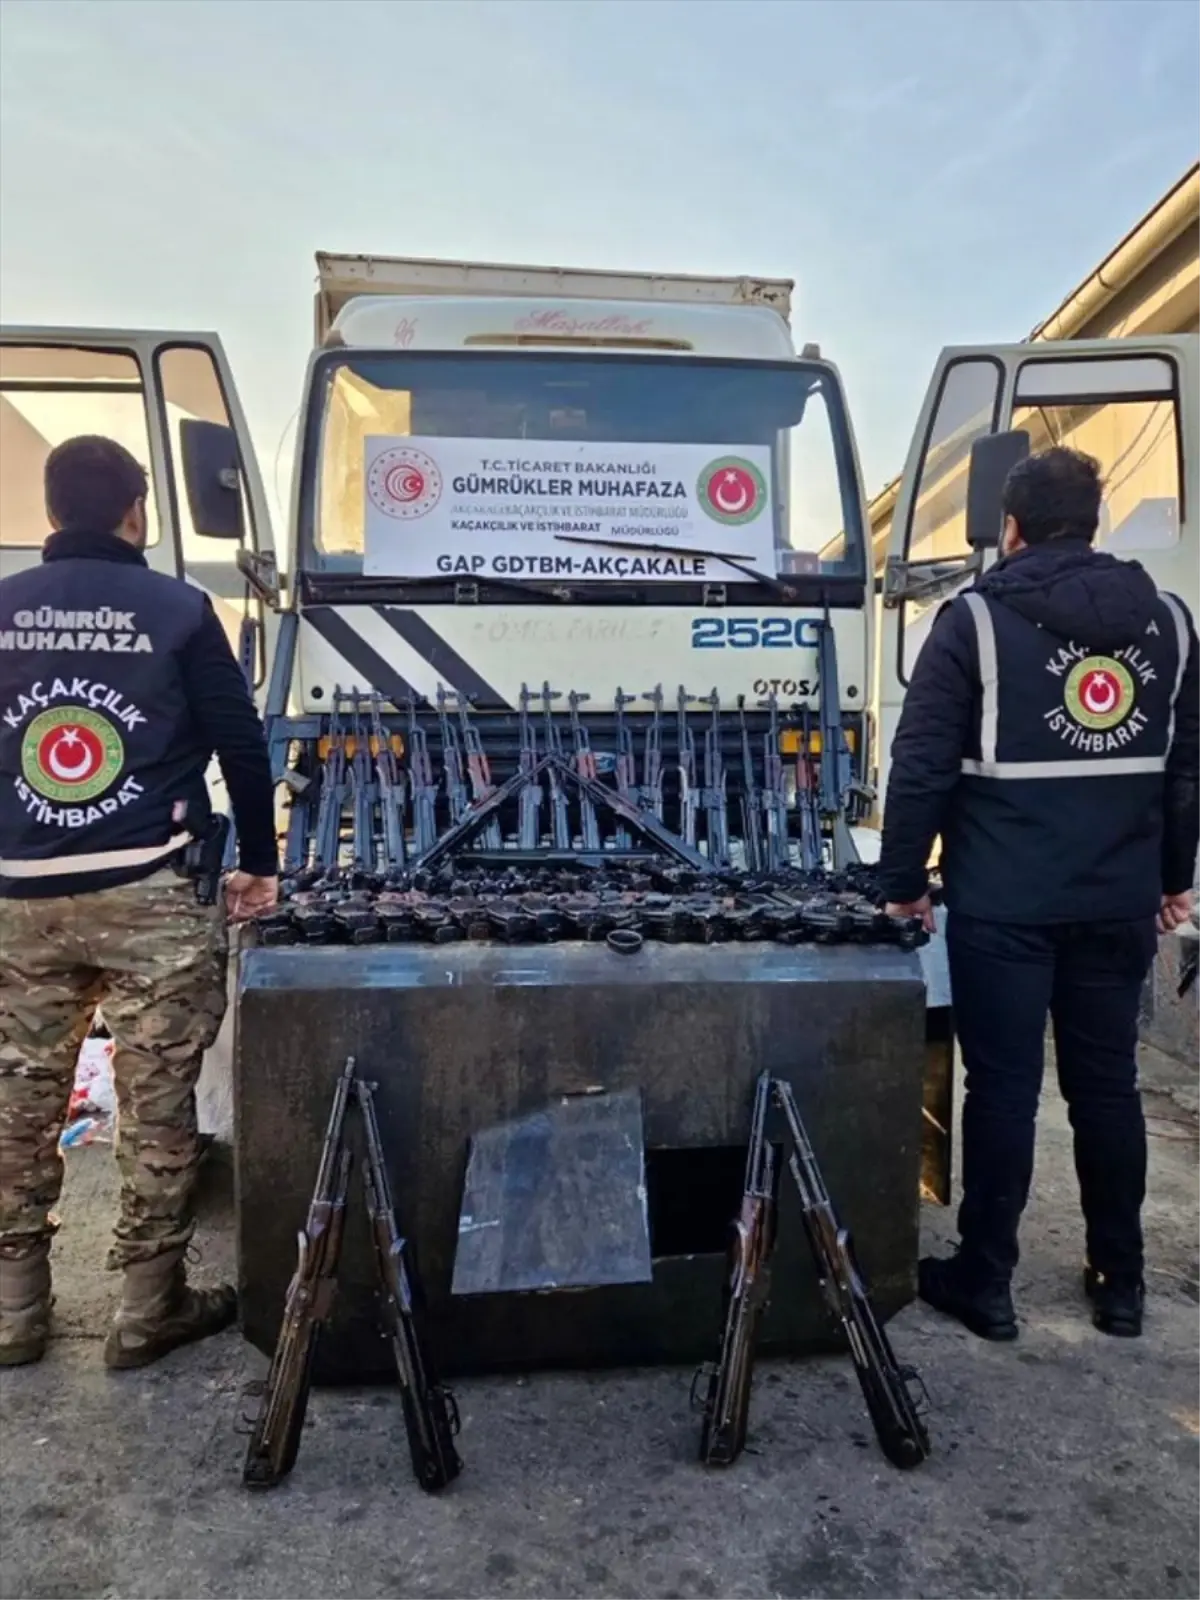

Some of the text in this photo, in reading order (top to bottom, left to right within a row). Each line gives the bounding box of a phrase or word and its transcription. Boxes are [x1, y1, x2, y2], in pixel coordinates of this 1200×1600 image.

[575, 461, 656, 475] BAKANLIĞI
[452, 472, 687, 498] GÜMRÜKLER MUHAFAZA
[451, 520, 518, 532] KAÇAKÇILIK
[520, 521, 535, 532] VE
[436, 555, 706, 578] GAP GDTBM-AKÇAKALE
[13, 606, 136, 631] GÜMRÜK
[0, 631, 153, 653] MUHAFAZA
[3, 677, 148, 732] KAÇAKÇILIK
[1043, 705, 1148, 753] İSTİHBARAT
[14, 776, 144, 828] İSTİHBARAT
